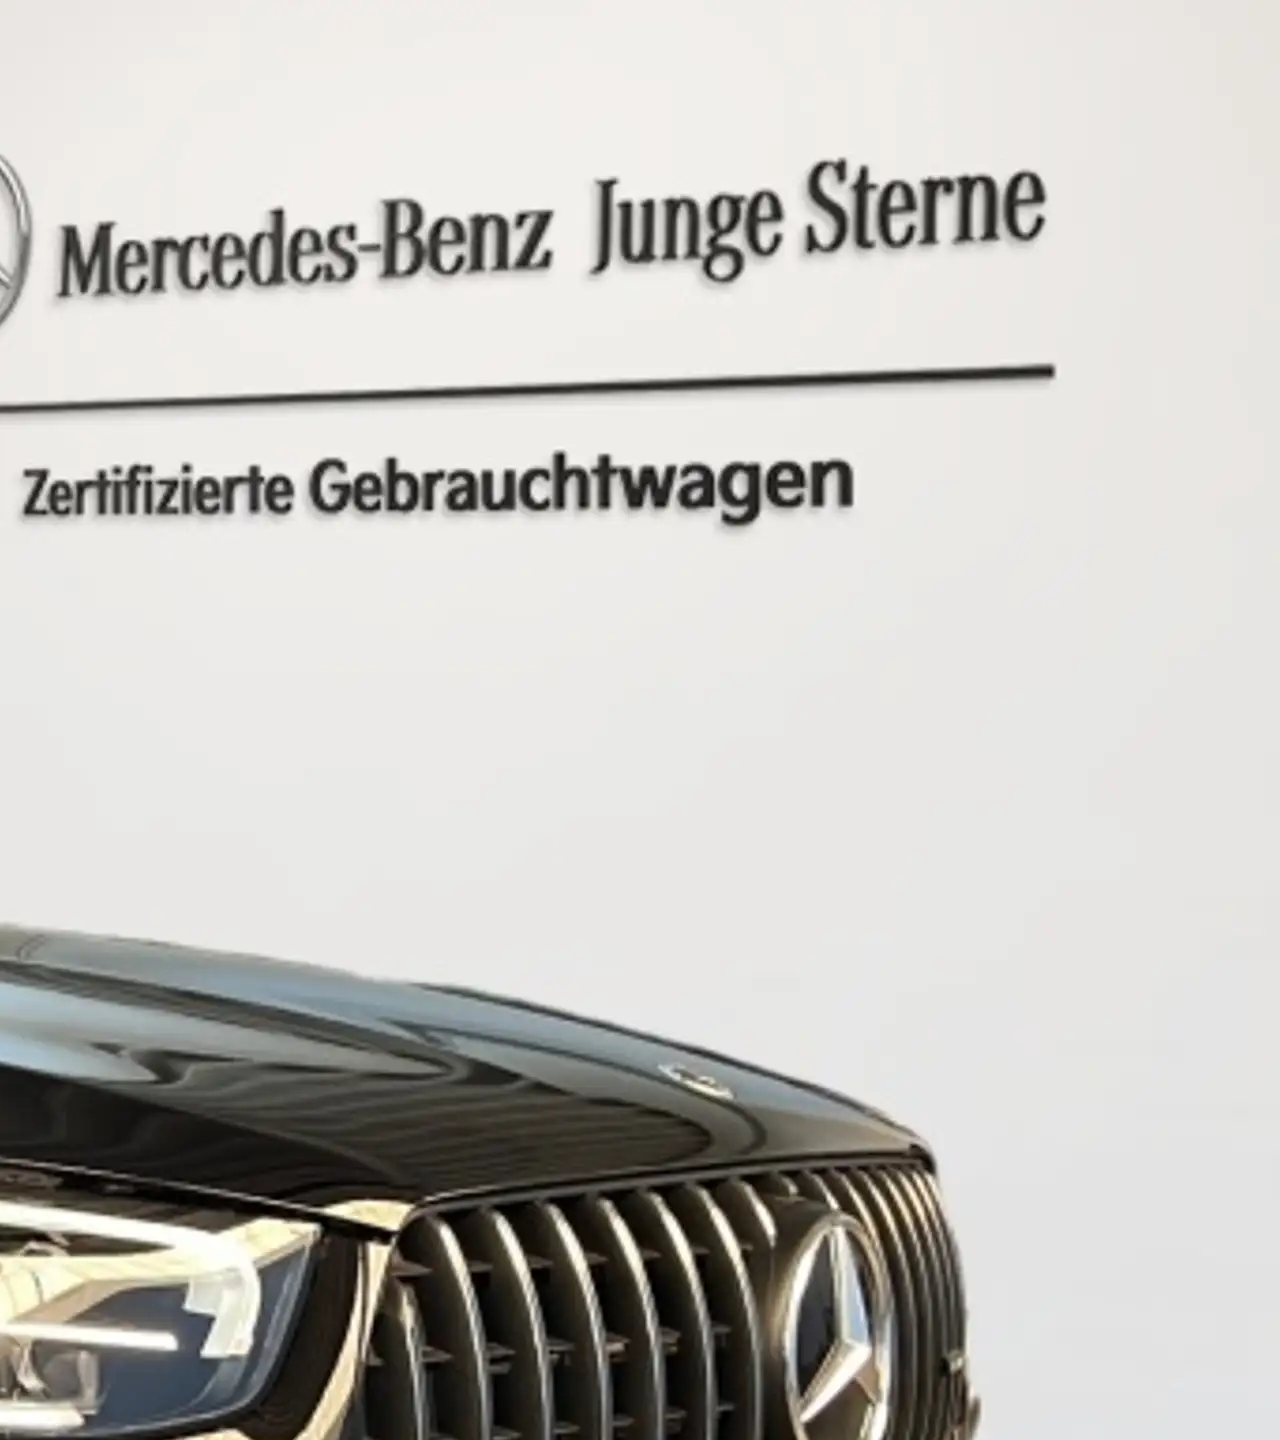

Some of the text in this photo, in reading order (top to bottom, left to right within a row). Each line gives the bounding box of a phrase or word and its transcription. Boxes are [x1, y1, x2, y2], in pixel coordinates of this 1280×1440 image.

[57, 158, 1047, 299] Mercedes-Benz Junge Sterne
[22, 450, 854, 528] Zertifizierte Gebrauchtwagen
